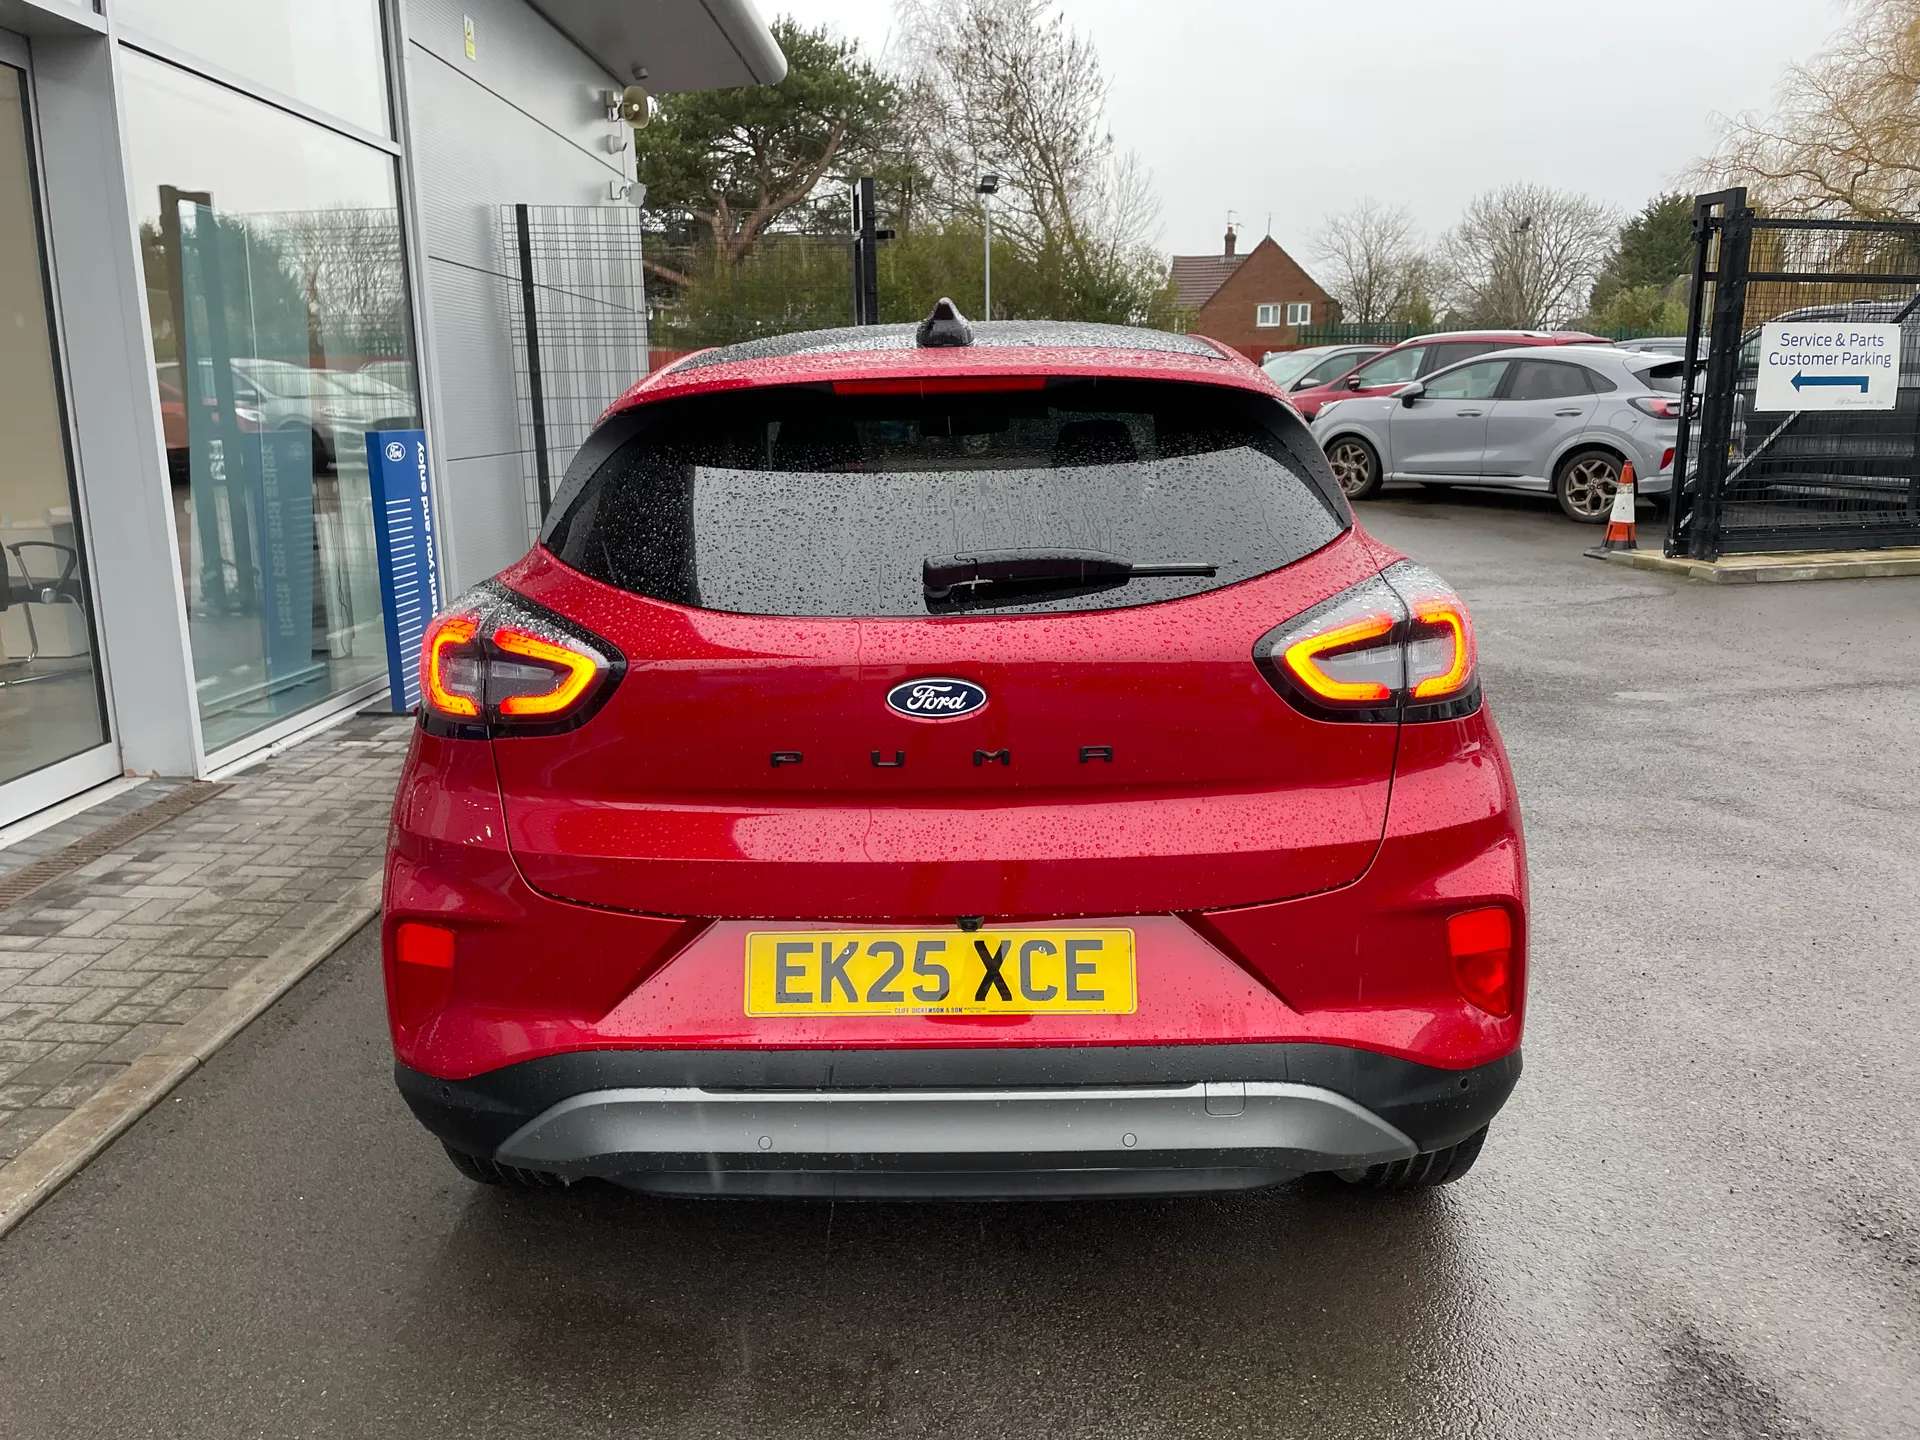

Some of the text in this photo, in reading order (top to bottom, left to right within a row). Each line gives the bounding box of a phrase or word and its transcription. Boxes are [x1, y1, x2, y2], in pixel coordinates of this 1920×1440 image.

[1780, 332, 1885, 347] Service & Parts
[1768, 352, 1892, 368] Customer Parking
[416, 441, 439, 618] hank you and enjoy
[906, 685, 967, 711] Ford
[770, 745, 1114, 768] PUMA
[774, 939, 1105, 1004] EK25 XCE
